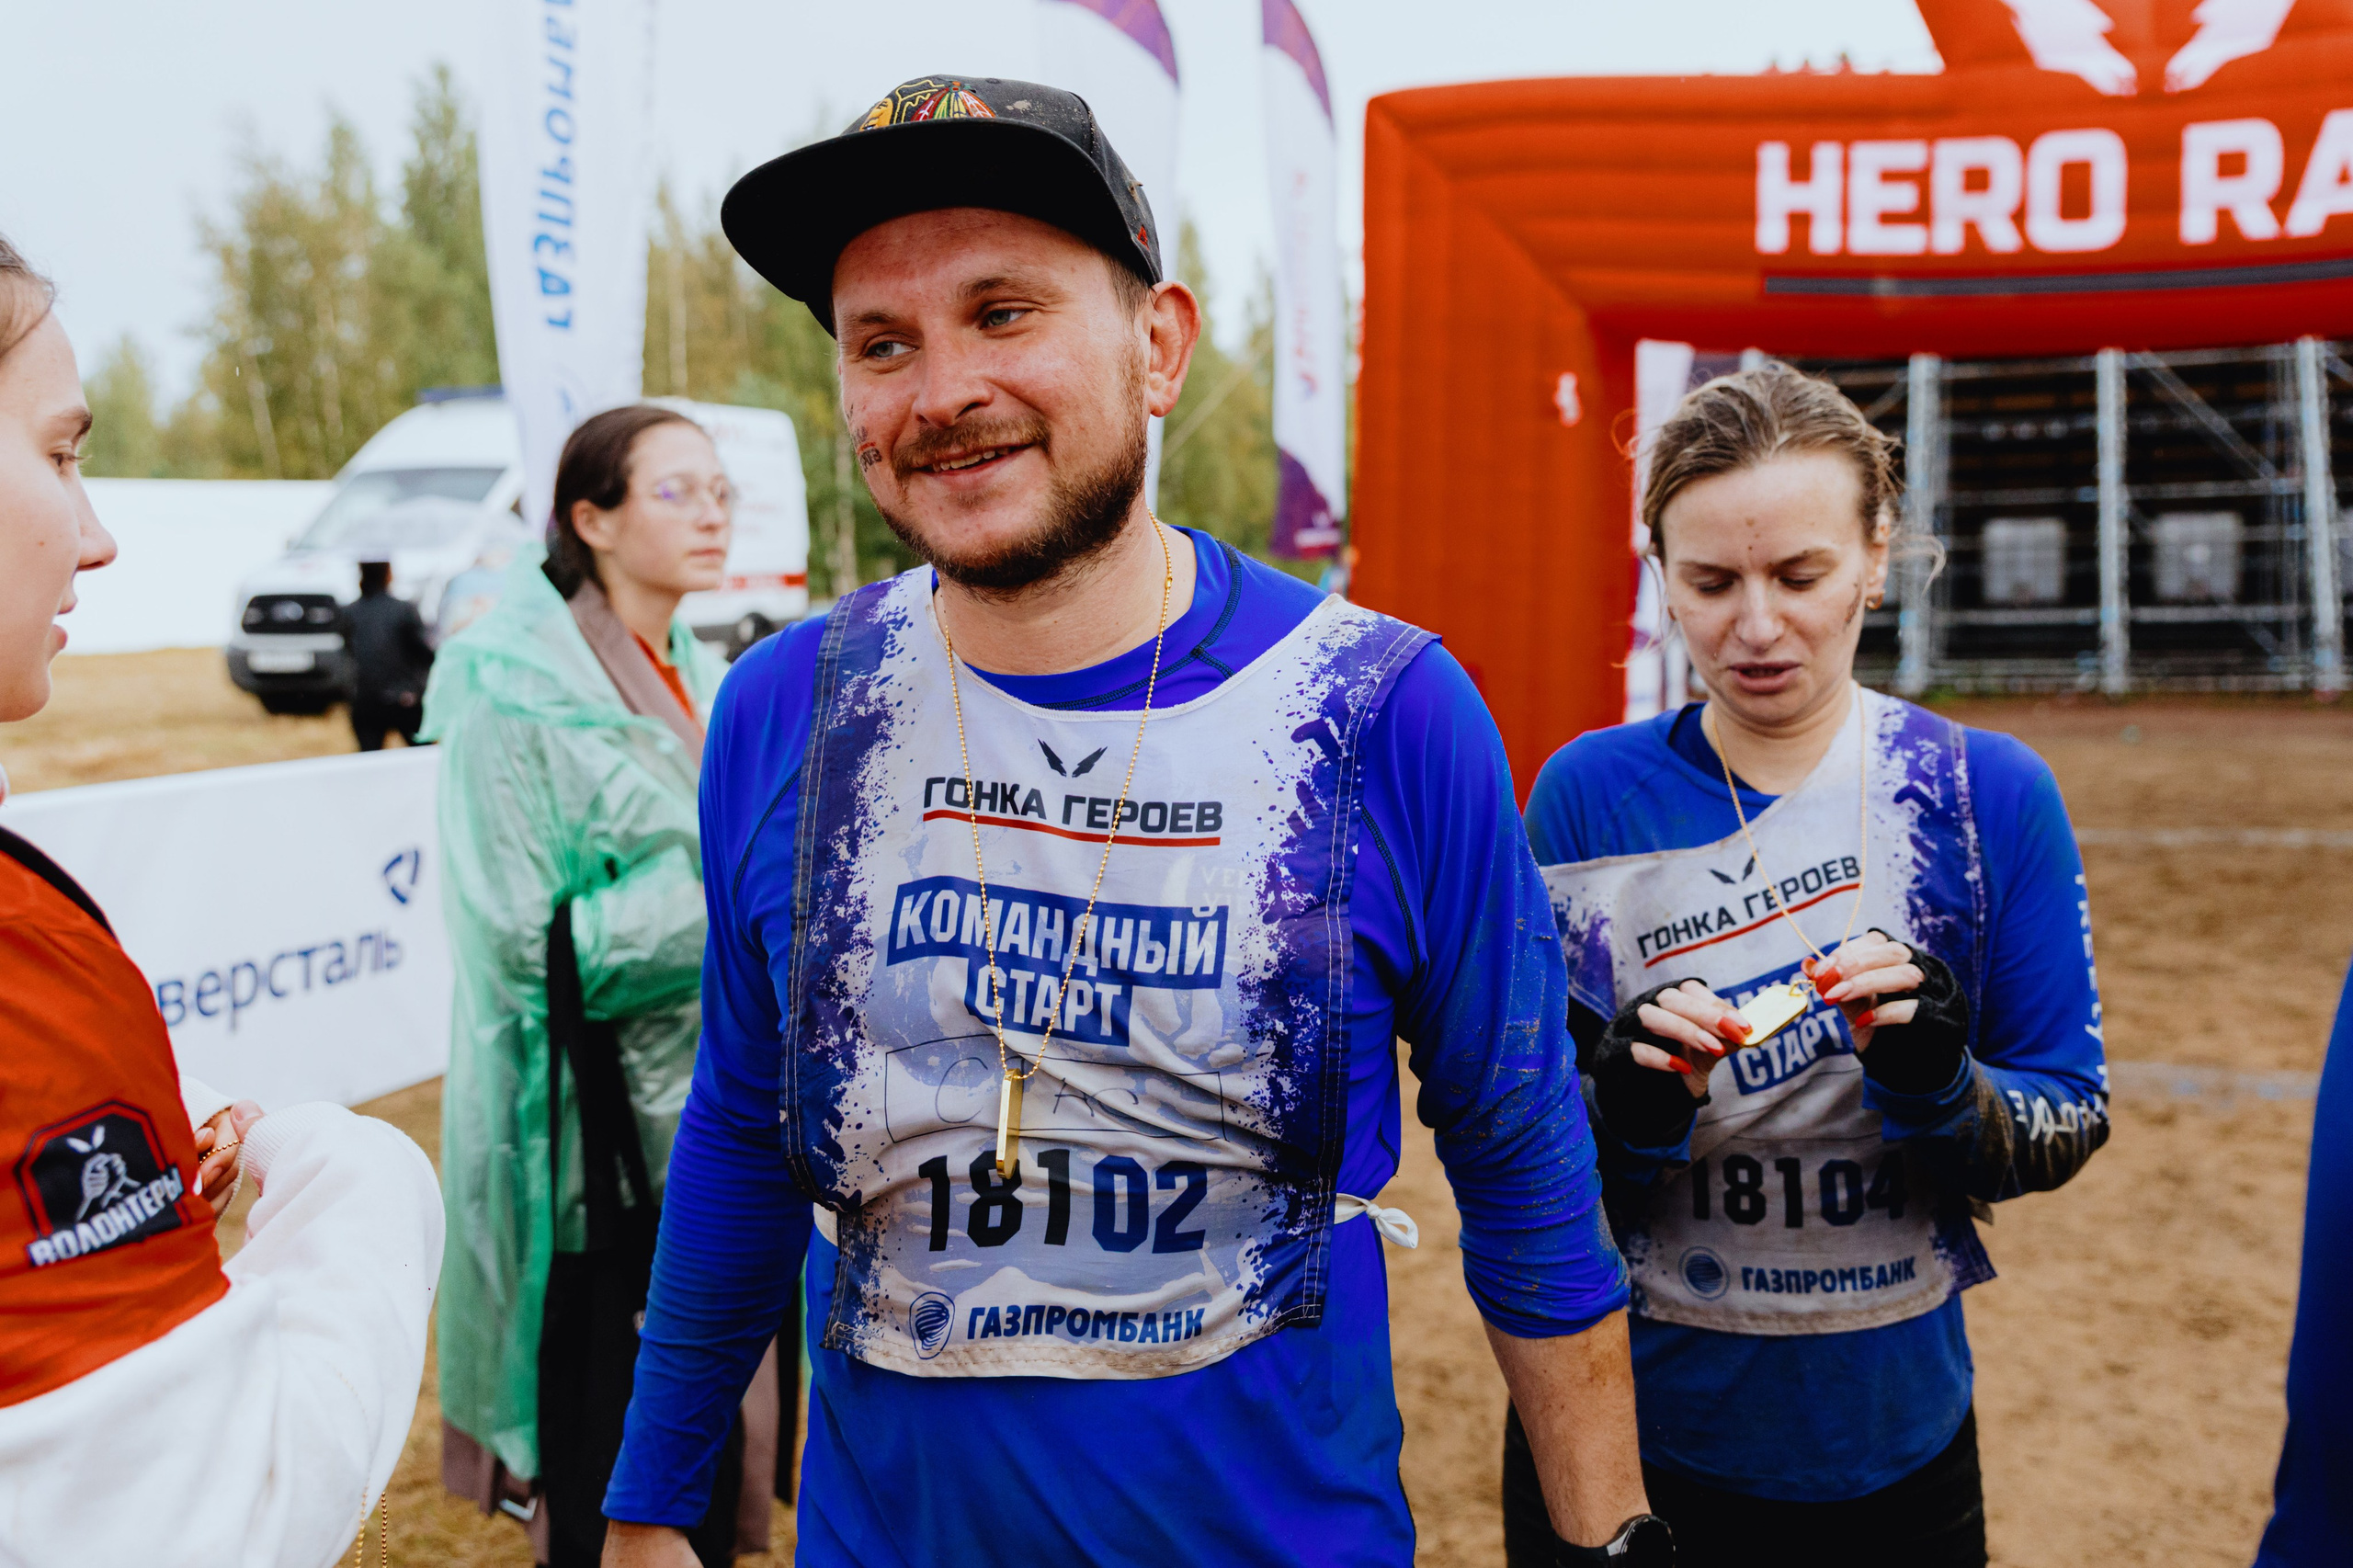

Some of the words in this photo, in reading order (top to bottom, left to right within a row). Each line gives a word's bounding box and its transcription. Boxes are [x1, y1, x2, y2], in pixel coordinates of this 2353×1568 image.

[1756, 130, 2128, 255] HERO
[2179, 108, 2353, 244] RA
[923, 776, 1046, 819] ГОНКА
[1061, 794, 1222, 832] ГЕРОЕВ
[896, 889, 1219, 976] КОМАНДНЫЙ
[1636, 905, 1736, 958] ГОНКА
[1744, 856, 1860, 919] ГЕРОЕВ
[975, 965, 1121, 1036] СТАРТ
[1736, 1008, 1843, 1087] СТАРТ
[28, 1167, 183, 1266] ВОЛОНТЕРЫ
[918, 1148, 1208, 1254] 18102
[1692, 1151, 1908, 1228] 18104
[1741, 1256, 1915, 1293] ГАЗПРОМБАНК
[967, 1304, 1205, 1344] ГАЗПРОМБАНК
